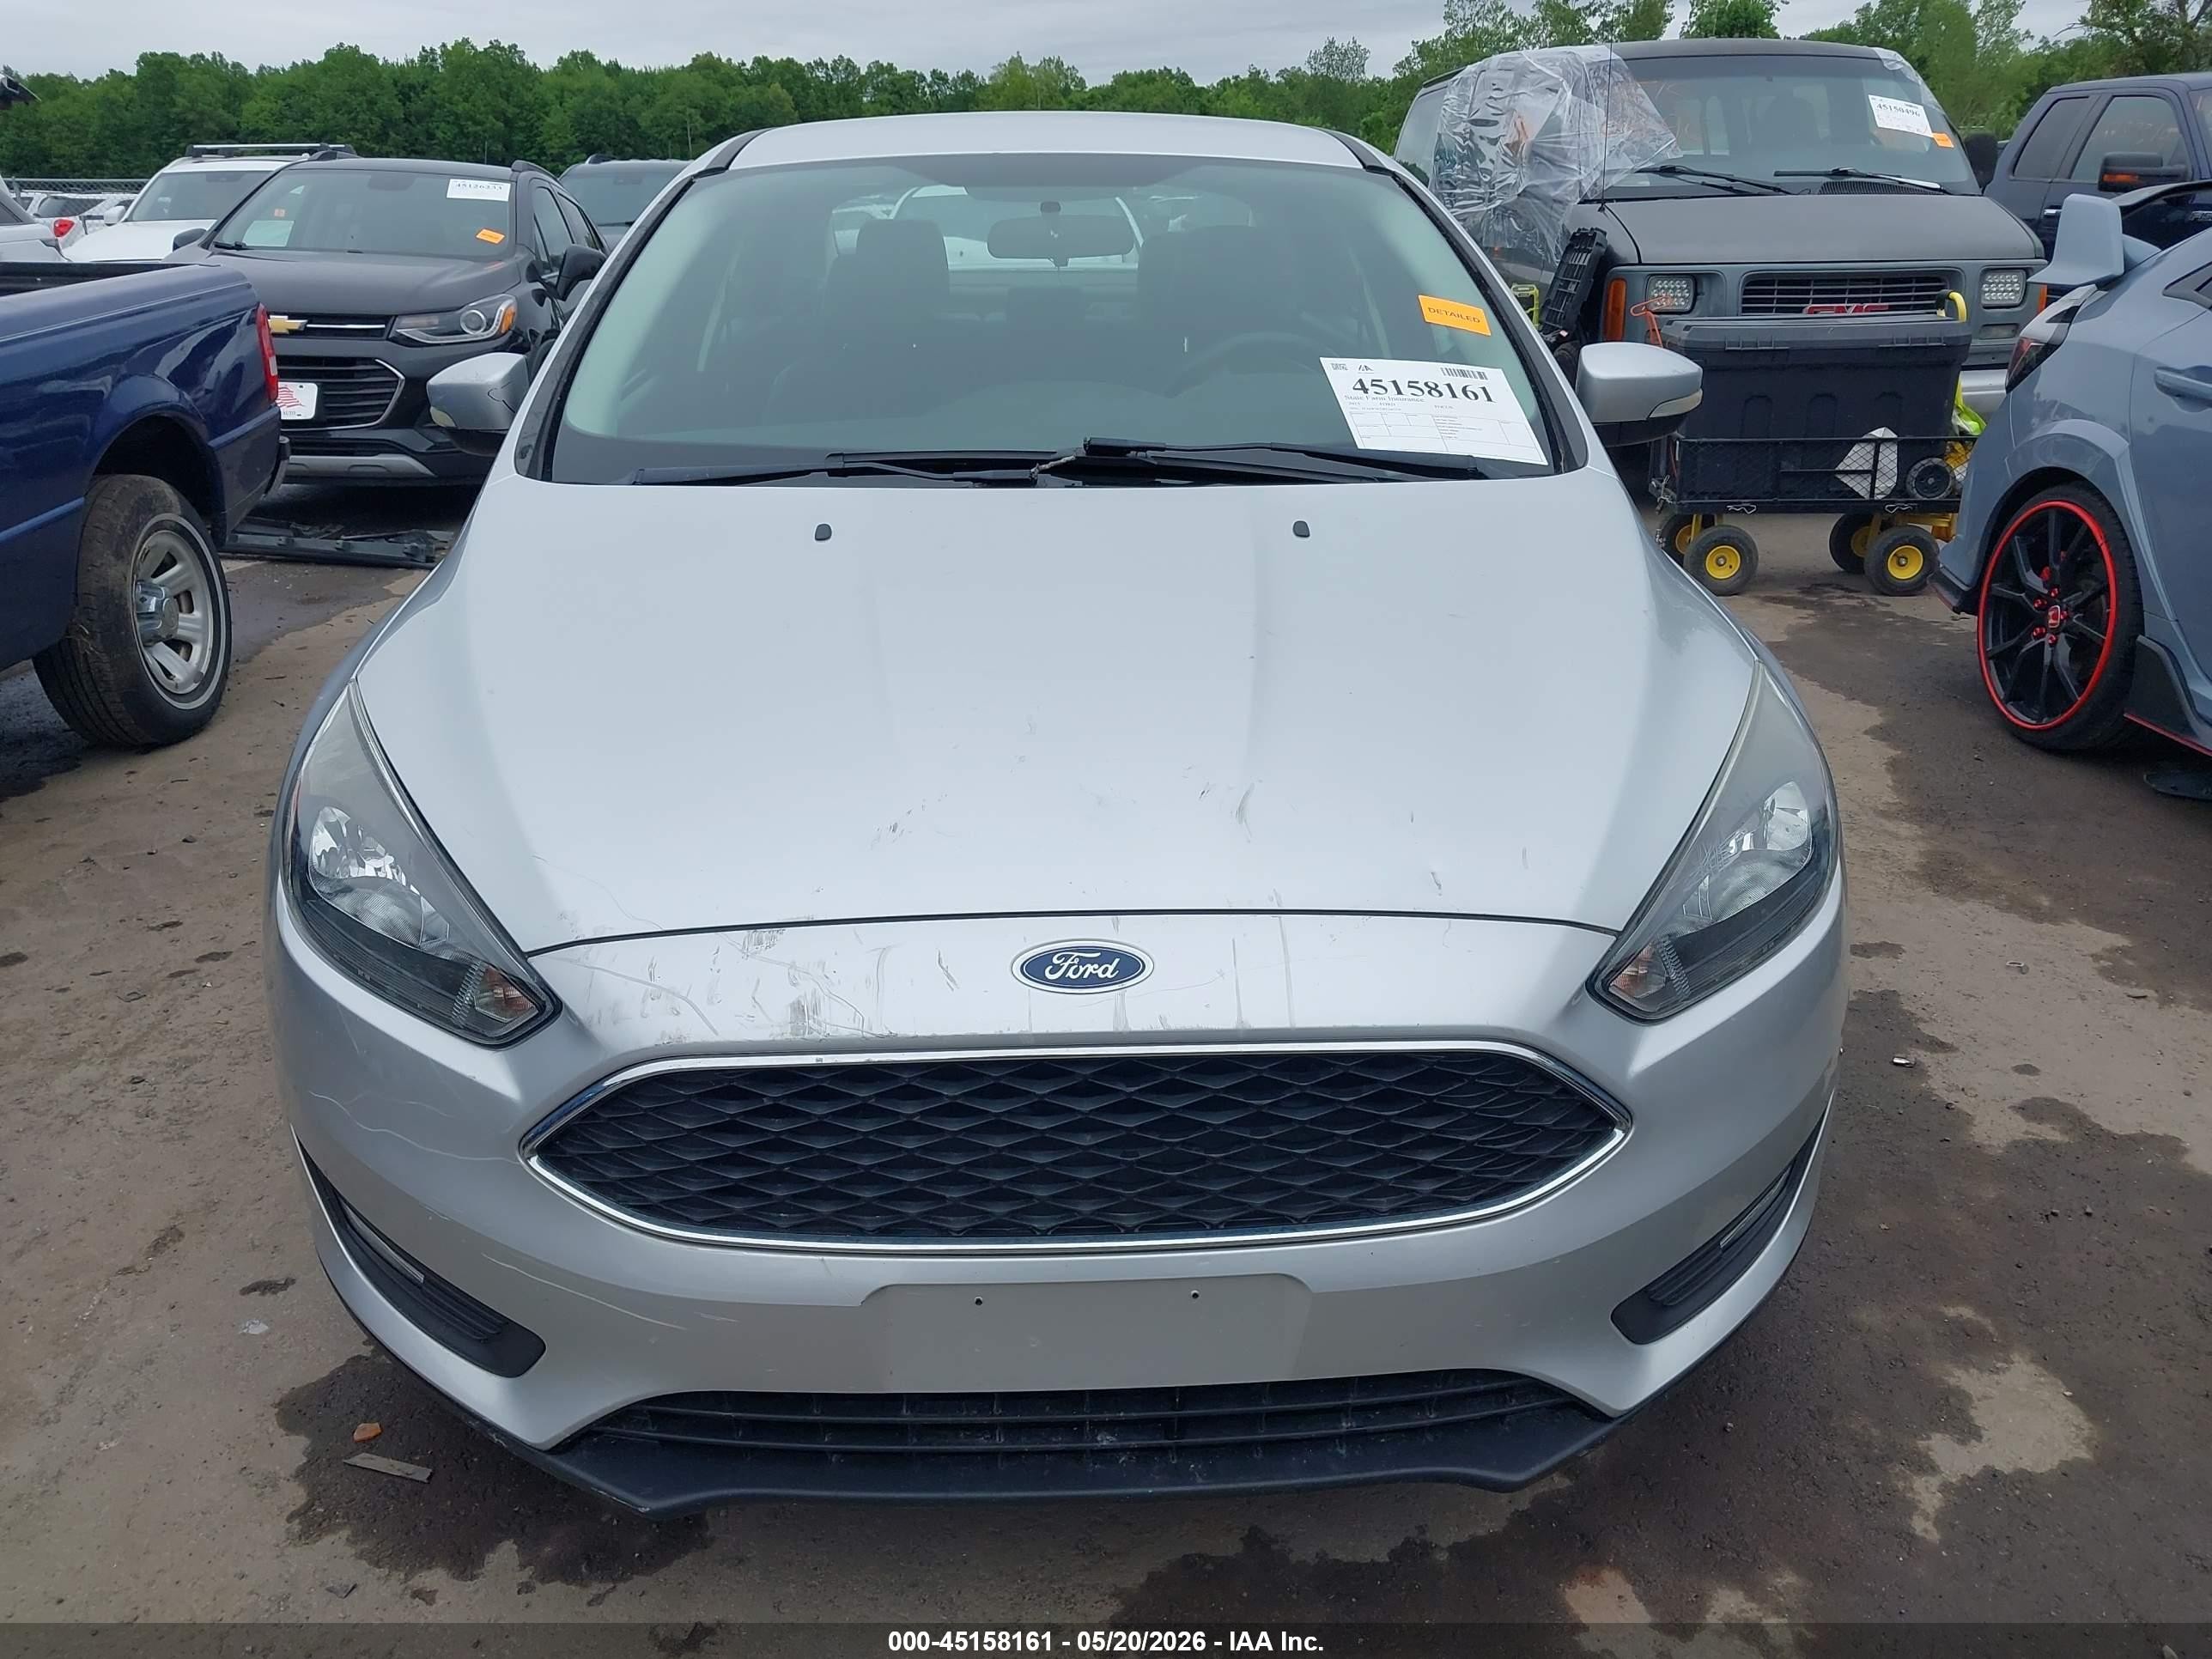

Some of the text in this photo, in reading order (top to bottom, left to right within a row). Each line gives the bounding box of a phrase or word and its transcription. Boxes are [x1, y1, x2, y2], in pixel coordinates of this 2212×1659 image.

[1428, 307, 1480, 323] DETAILED
[1352, 378, 1496, 403] 45158161
[1045, 951, 1120, 980] Ford
